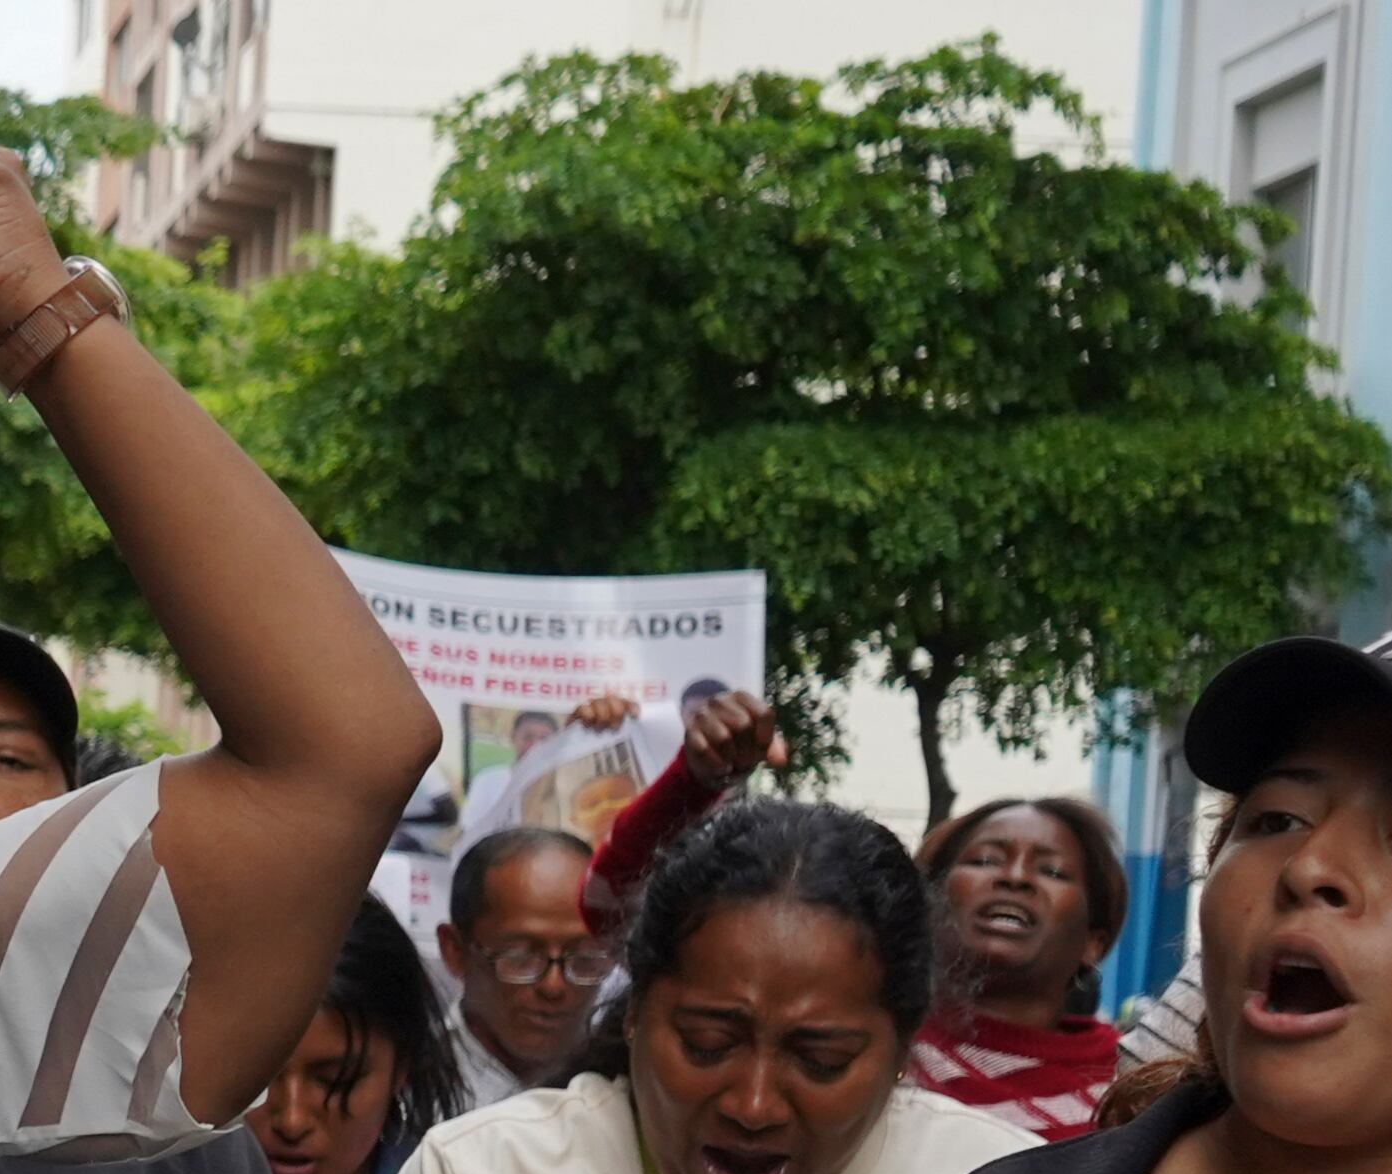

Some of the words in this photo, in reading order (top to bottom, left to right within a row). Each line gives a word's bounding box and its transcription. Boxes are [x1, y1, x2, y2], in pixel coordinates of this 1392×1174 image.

[361, 594, 414, 622] ON
[428, 604, 723, 639] SECUESTRADOS
[430, 643, 480, 662] SUS
[489, 651, 624, 671] NOMBRES
